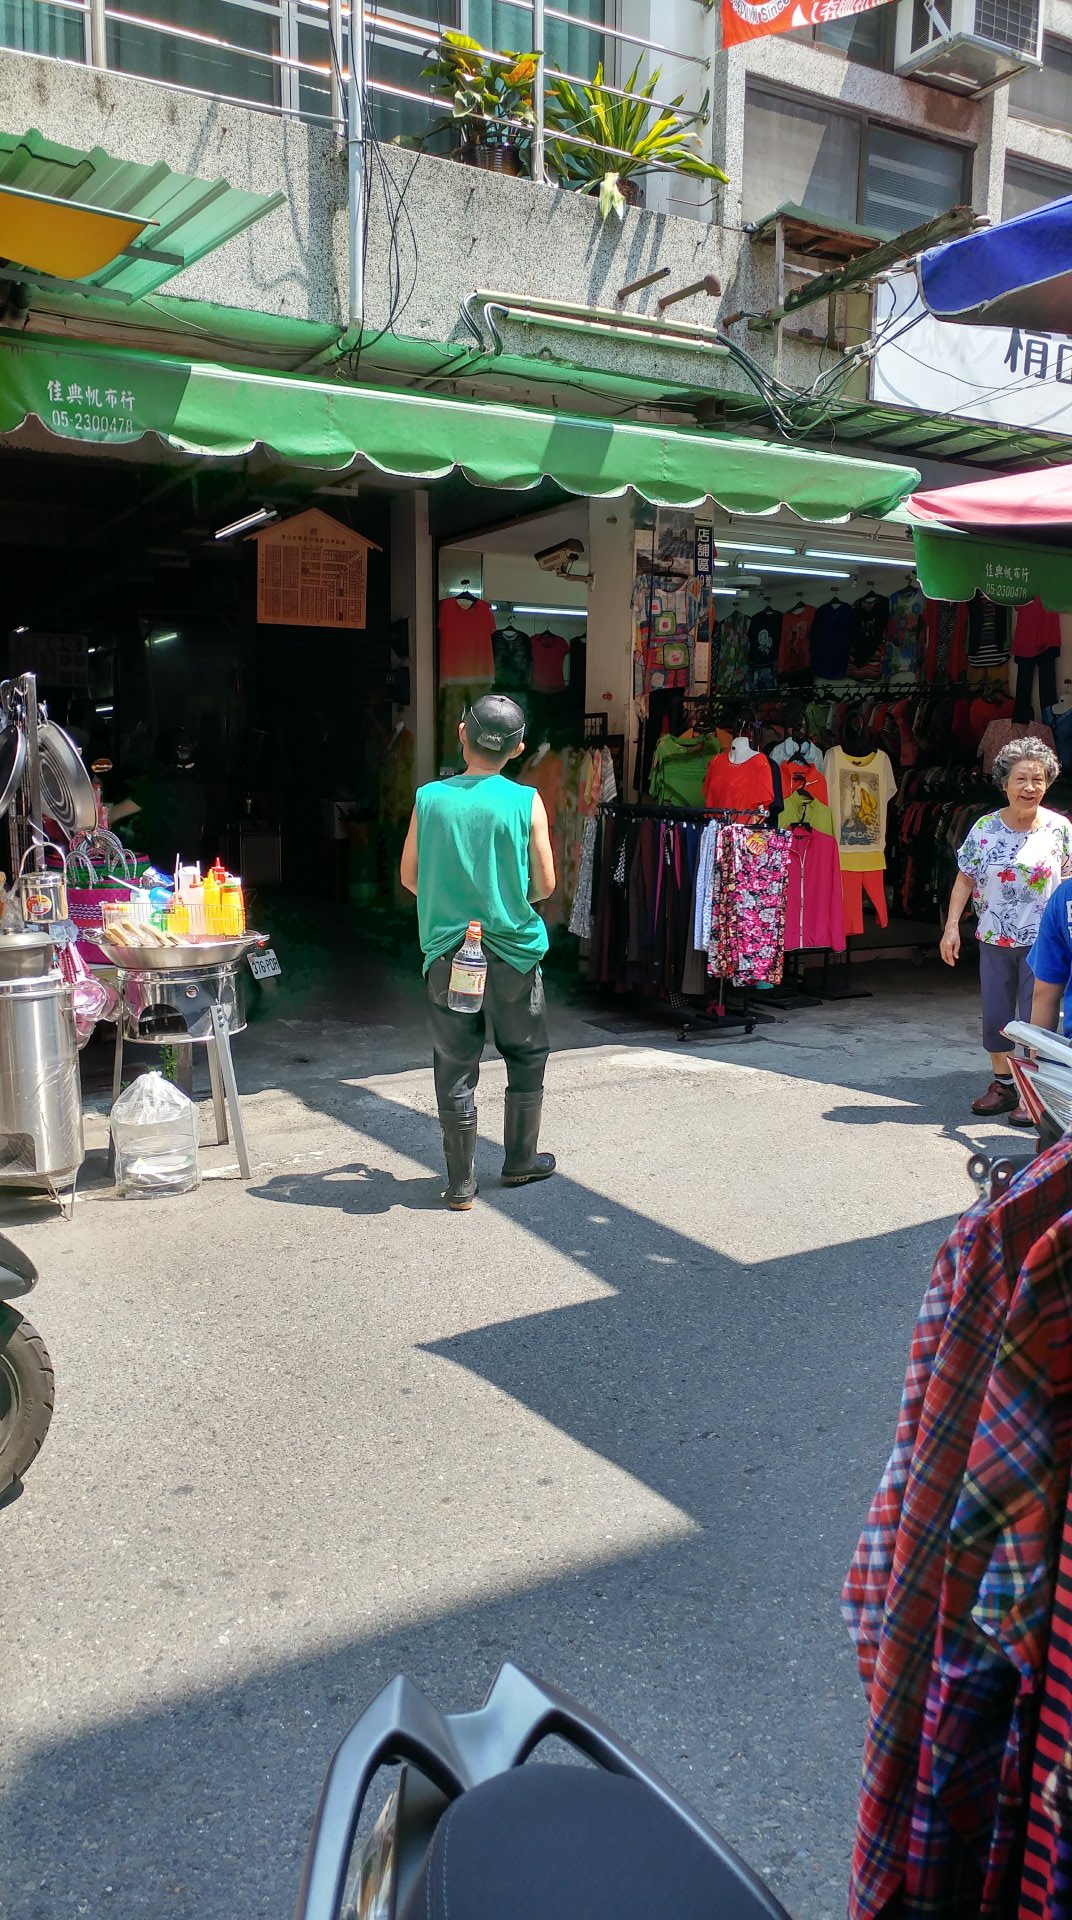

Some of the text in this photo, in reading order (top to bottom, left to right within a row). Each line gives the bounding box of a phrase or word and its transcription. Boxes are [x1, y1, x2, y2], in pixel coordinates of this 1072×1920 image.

[48, 381, 135, 411] 佳典帆布行
[52, 411, 133, 434] 05-2300478
[986, 563, 1030, 583] 佳典帆布行
[986, 583, 1028, 599] 05-2300478
